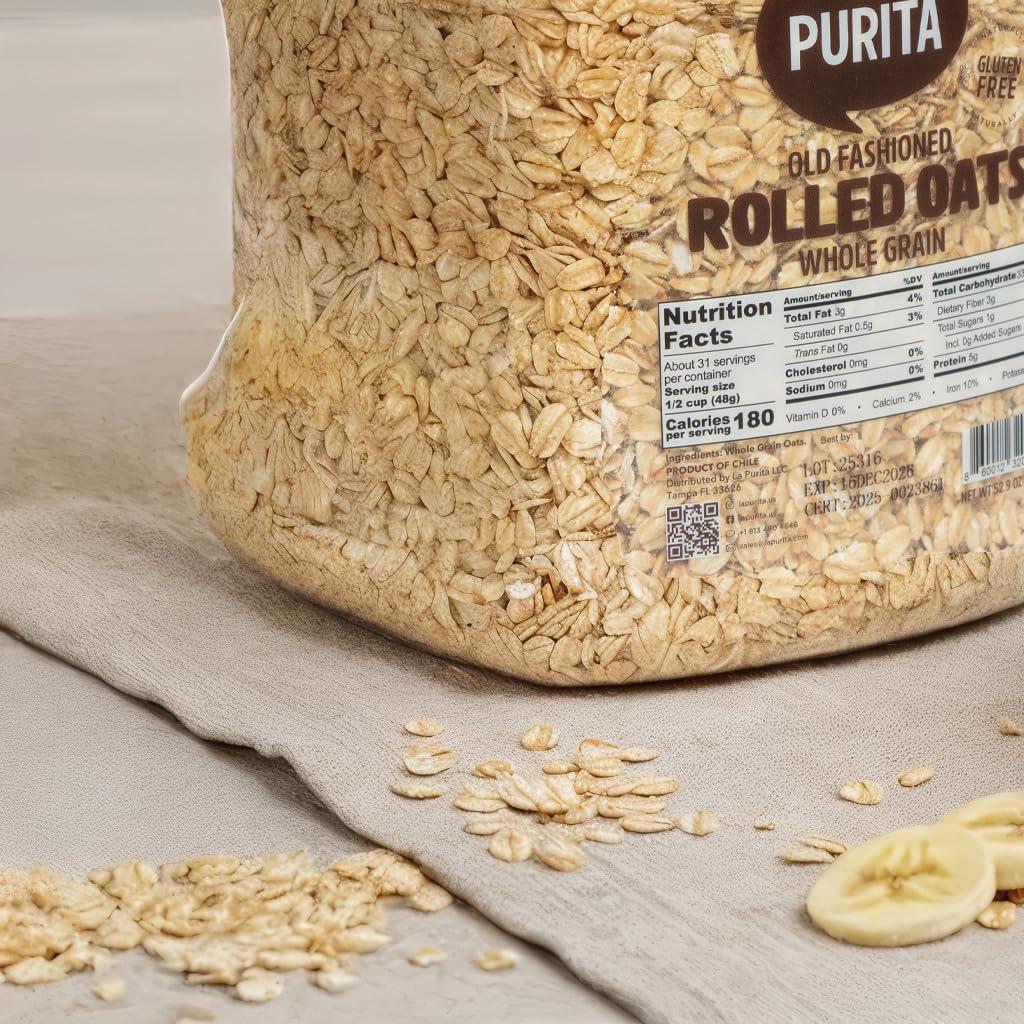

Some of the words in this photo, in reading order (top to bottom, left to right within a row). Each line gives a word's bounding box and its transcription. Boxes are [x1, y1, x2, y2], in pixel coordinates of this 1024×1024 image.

[978, 55, 1021, 74] GLUTEN
[977, 76, 1017, 99] FREE
[970, 109, 1016, 127] NATURALLY
[788, 147, 830, 178] OLD
[838, 128, 952, 171] FASHIONED
[688, 174, 905, 252] ROLLED
[800, 239, 877, 276] WHOLE
[885, 228, 945, 264] GRAIN
[933, 262, 990, 280] Amount/serving
[784, 289, 852, 305] Amount/serving
[904, 275, 922, 285] %DV
[933, 286, 956, 298] Total
[959, 273, 1016, 292] Carbohydrate
[664, 301, 772, 325] Nutrition
[784, 311, 811, 323] Total
[815, 308, 832, 319] Fat
[835, 308, 845, 317] 3g
[907, 293, 922, 303] 4%
[937, 304, 964, 315] Dietary
[966, 299, 984, 309] Fiber
[987, 296, 996, 306] 3g
[793, 327, 835, 340] Saturated
[839, 323, 853, 333] Fat
[855, 321, 873, 331] 0.5g
[908, 312, 923, 321] 3%
[938, 323, 956, 332] Total
[958, 317, 983, 329] Sugars
[987, 314, 995, 323] 1g
[664, 328, 733, 349] Facts
[945, 340, 959, 349] Incl.
[962, 337, 972, 347] 0g
[973, 331, 996, 342] Added
[998, 324, 1022, 336] Sugars
[795, 346, 818, 358] Trans
[821, 345, 835, 354] Fat
[837, 343, 848, 352] 0g
[664, 360, 694, 372] About
[697, 358, 709, 368] 31
[713, 354, 756, 367] servings
[786, 361, 847, 377] Cholesterol
[849, 358, 868, 368] 0mg
[908, 347, 923, 357] 0%
[933, 356, 966, 369] Protein
[969, 353, 978, 362] 5g
[664, 375, 681, 386] per
[684, 369, 732, 382] container
[786, 382, 825, 395] Sodium
[828, 379, 847, 390] 0mg
[908, 365, 923, 374] 0%
[665, 384, 709, 396] Serving
[712, 381, 735, 391] size
[665, 399, 682, 409] 1/2
[686, 399, 707, 408] cup
[711, 393, 740, 407] (48g)
[786, 410, 819, 423] Vitamin
[821, 408, 828, 417] D
[832, 406, 846, 416] 0%
[873, 396, 905, 409] Calcium
[909, 392, 921, 401] 2%
[947, 384, 960, 393] Iron
[963, 379, 979, 389] 10%
[666, 414, 730, 431] Calories
[734, 409, 774, 429] 180
[666, 431, 684, 441] per
[688, 426, 730, 437] serving
[821, 436, 838, 444] Best
[840, 433, 853, 442] by:
[666, 451, 722, 462] Ingredients:
[726, 446, 754, 455] Whole
[758, 443, 781, 452] Grain
[784, 439, 806, 447] Oats.
[666, 464, 713, 475] PRODUCT
[717, 462, 729, 470] OF
[732, 458, 759, 468] CHILE
[964, 473, 969, 481] 8
[982, 463, 1005, 477] 60012
[666, 476, 716, 487] Distributed
[720, 474, 730, 482] by
[745, 468, 769, 478] Purita
[667, 491, 697, 501] Tampa
[713, 484, 741, 494] 33626
[962, 489, 976, 504] NET
[979, 485, 991, 498] WT
[1013, 476, 1022, 489] OZ
[739, 498, 776, 507] lapurita.us
